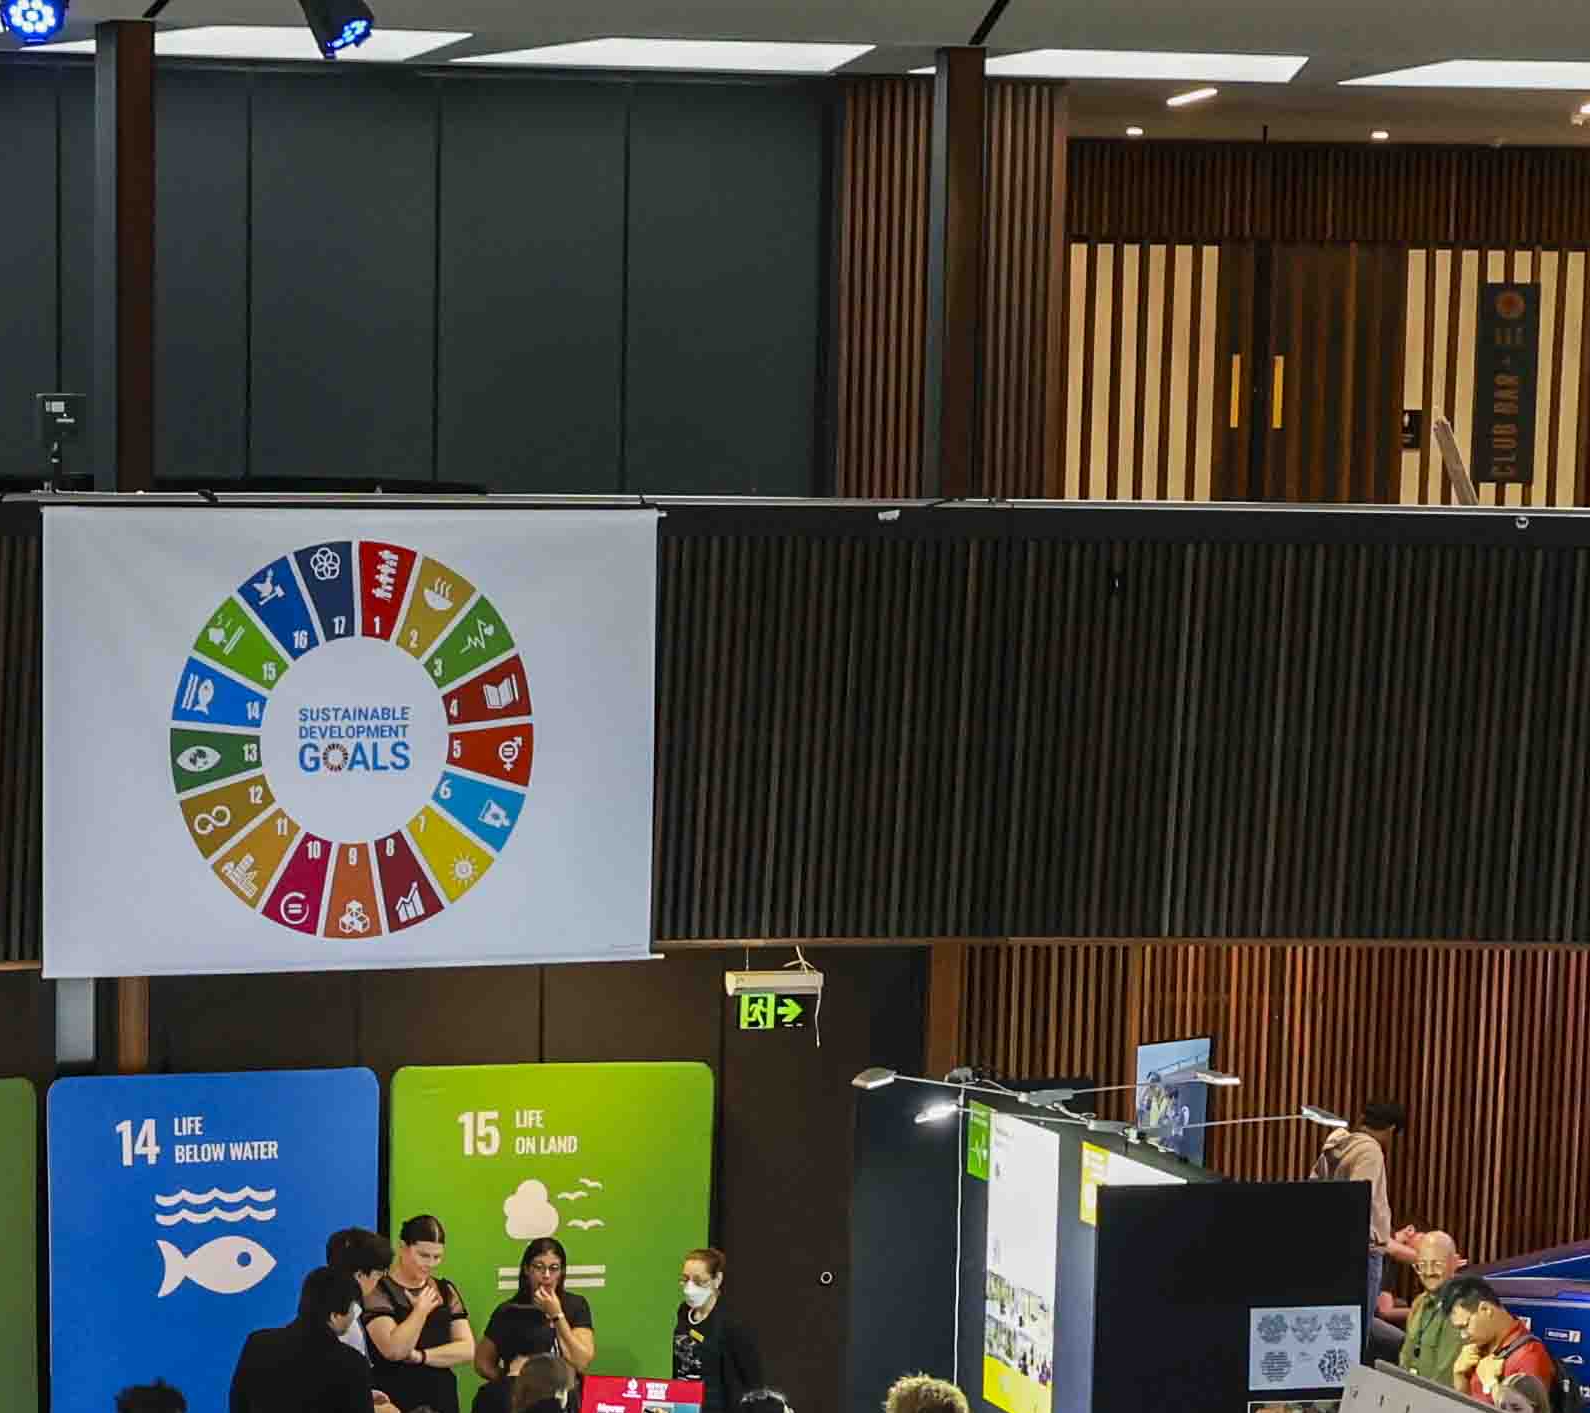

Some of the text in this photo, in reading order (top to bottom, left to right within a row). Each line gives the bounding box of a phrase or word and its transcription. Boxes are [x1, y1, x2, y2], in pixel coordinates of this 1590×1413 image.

[374, 616, 380, 634] 1
[434, 658, 443, 677] 3
[298, 706, 411, 722] SUSTAINABLE
[299, 724, 408, 739] DEVELOPMENT
[299, 741, 410, 772] GOALS
[174, 1116, 203, 1136] LIFE
[516, 1109, 545, 1128] LIFE
[116, 1118, 160, 1166] 14
[457, 1111, 501, 1155] 15
[175, 1141, 278, 1164] BELOW WATER
[515, 1135, 578, 1154] ON LAND
